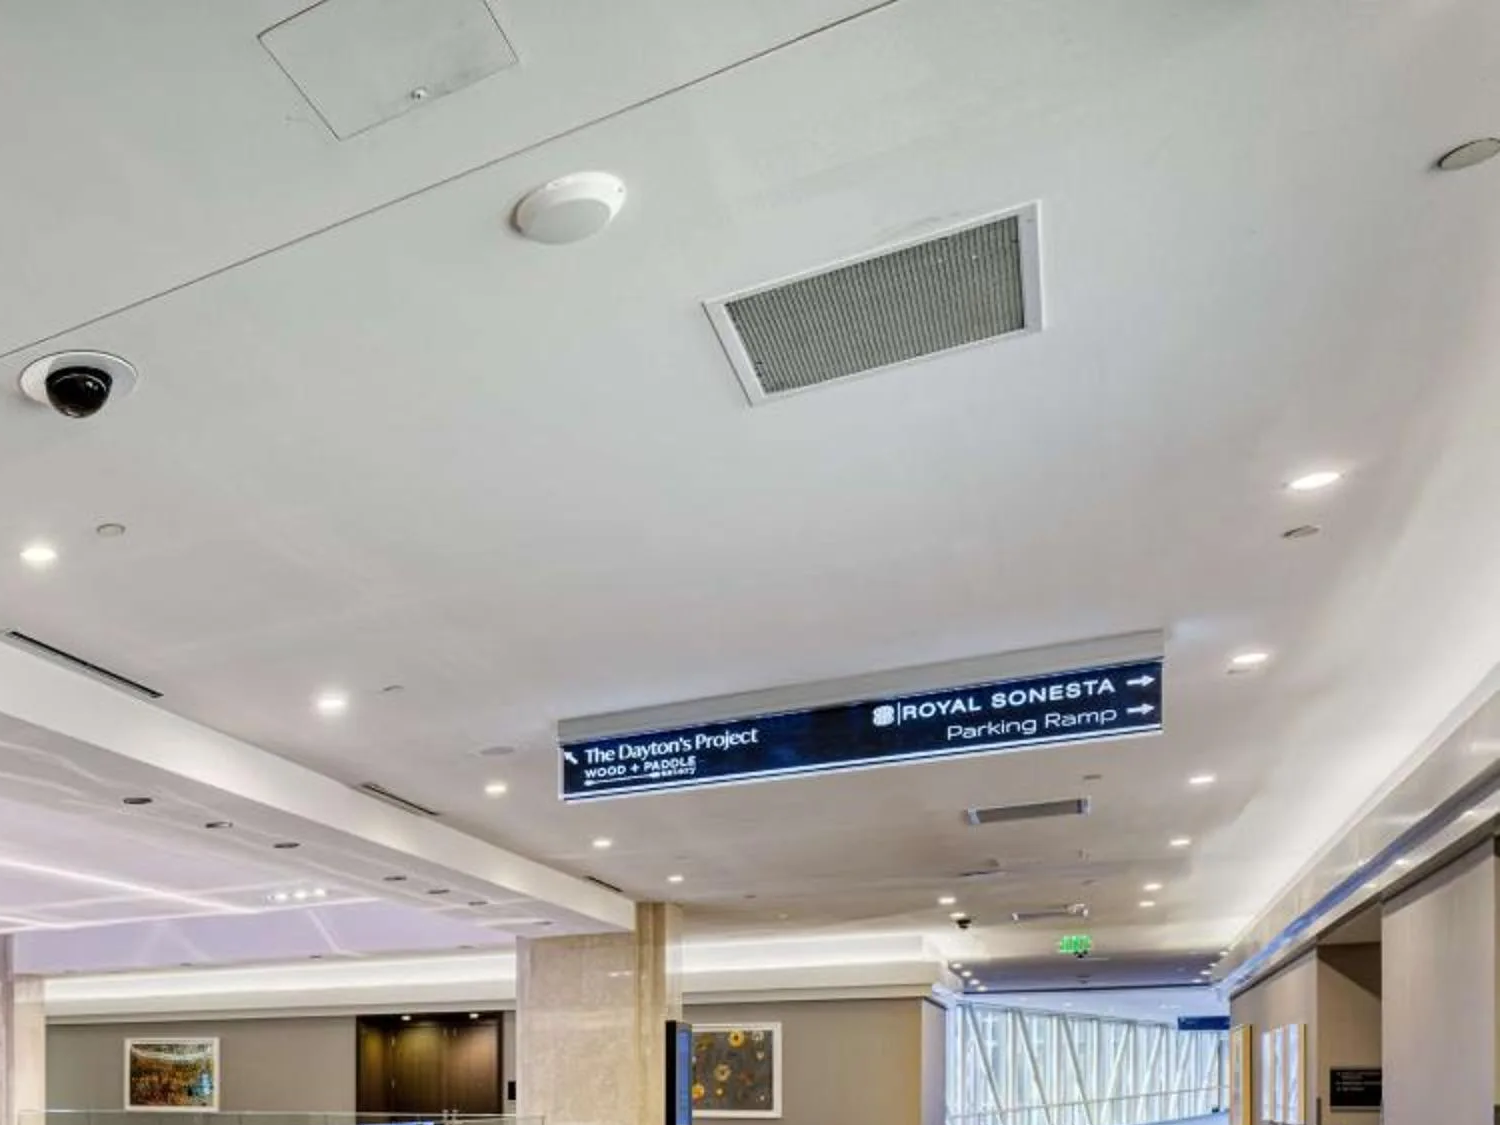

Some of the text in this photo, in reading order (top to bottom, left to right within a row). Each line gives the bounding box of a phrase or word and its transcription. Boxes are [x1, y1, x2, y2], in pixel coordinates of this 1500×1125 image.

[903, 678, 1116, 721] ROYAL SONESTA
[946, 708, 1118, 741] Parking Ramp
[584, 728, 759, 764] The Dayton's Project
[584, 765, 627, 778] WOOD
[643, 755, 697, 772] PADDLE
